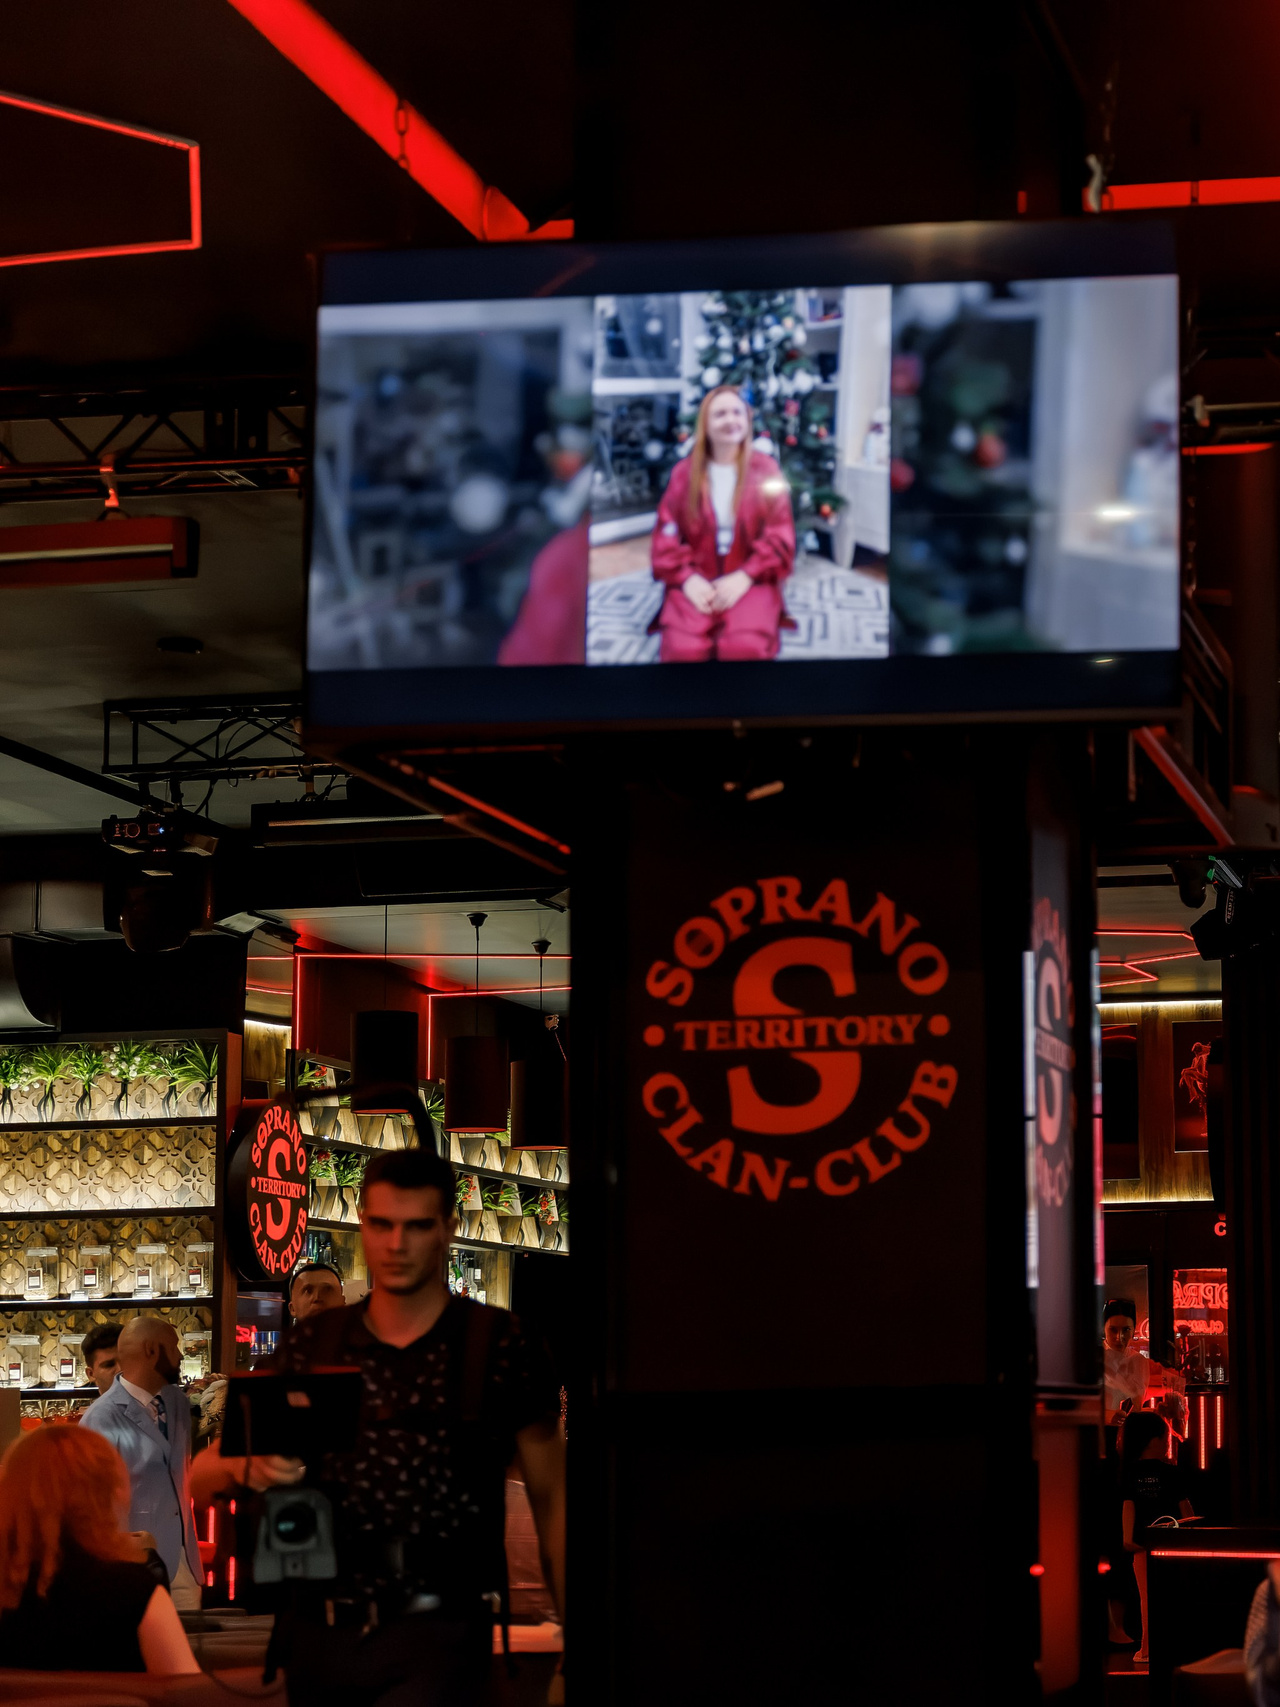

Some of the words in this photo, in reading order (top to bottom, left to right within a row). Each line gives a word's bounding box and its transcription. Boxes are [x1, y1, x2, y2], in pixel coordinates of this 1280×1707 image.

[646, 876, 949, 1007] SOPRANO
[674, 1014, 923, 1051] TERRITORY
[252, 1105, 306, 1175] SOPRANO
[642, 1060, 958, 1202] CLAN-CLUB
[257, 1177, 302, 1198] TERRITORY
[250, 1202, 307, 1274] CLAN-CLUB
